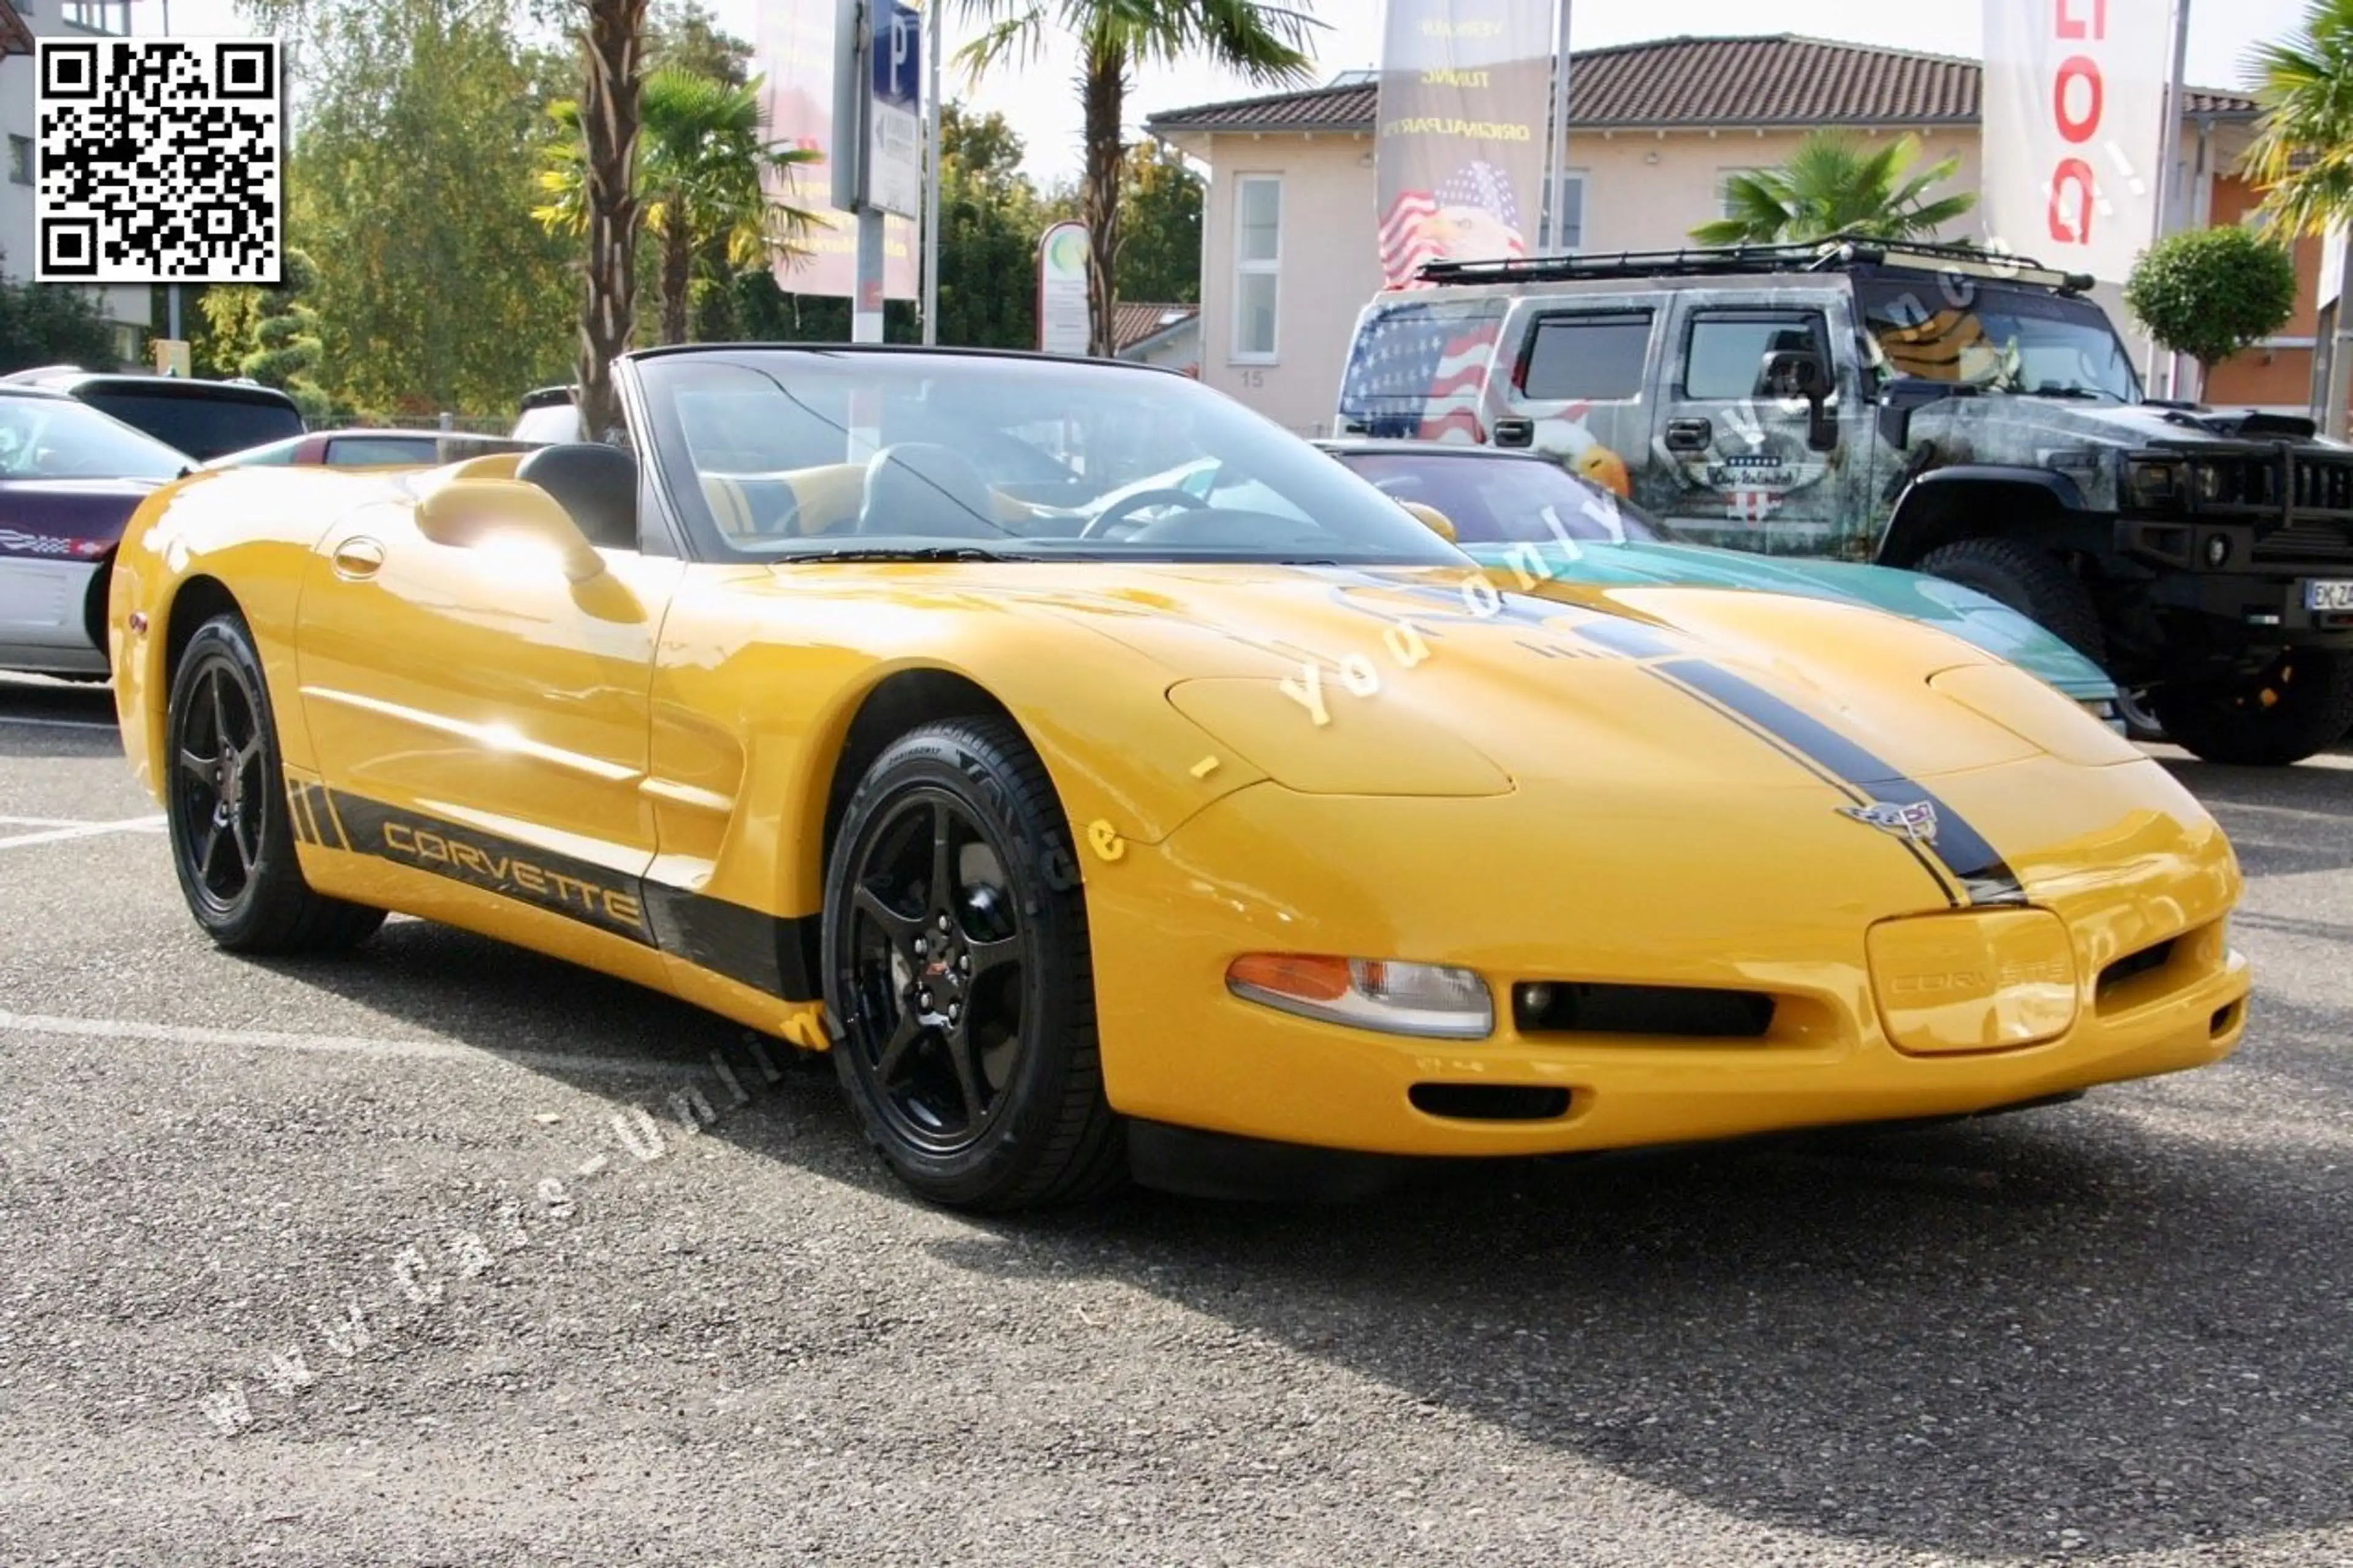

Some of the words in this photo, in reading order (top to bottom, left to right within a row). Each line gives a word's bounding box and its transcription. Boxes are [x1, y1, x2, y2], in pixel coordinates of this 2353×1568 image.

[890, 11, 907, 94] P
[1241, 371, 1264, 388] 15
[384, 820, 643, 928] CORVETTE
[1891, 960, 2065, 994] CORVETTE
